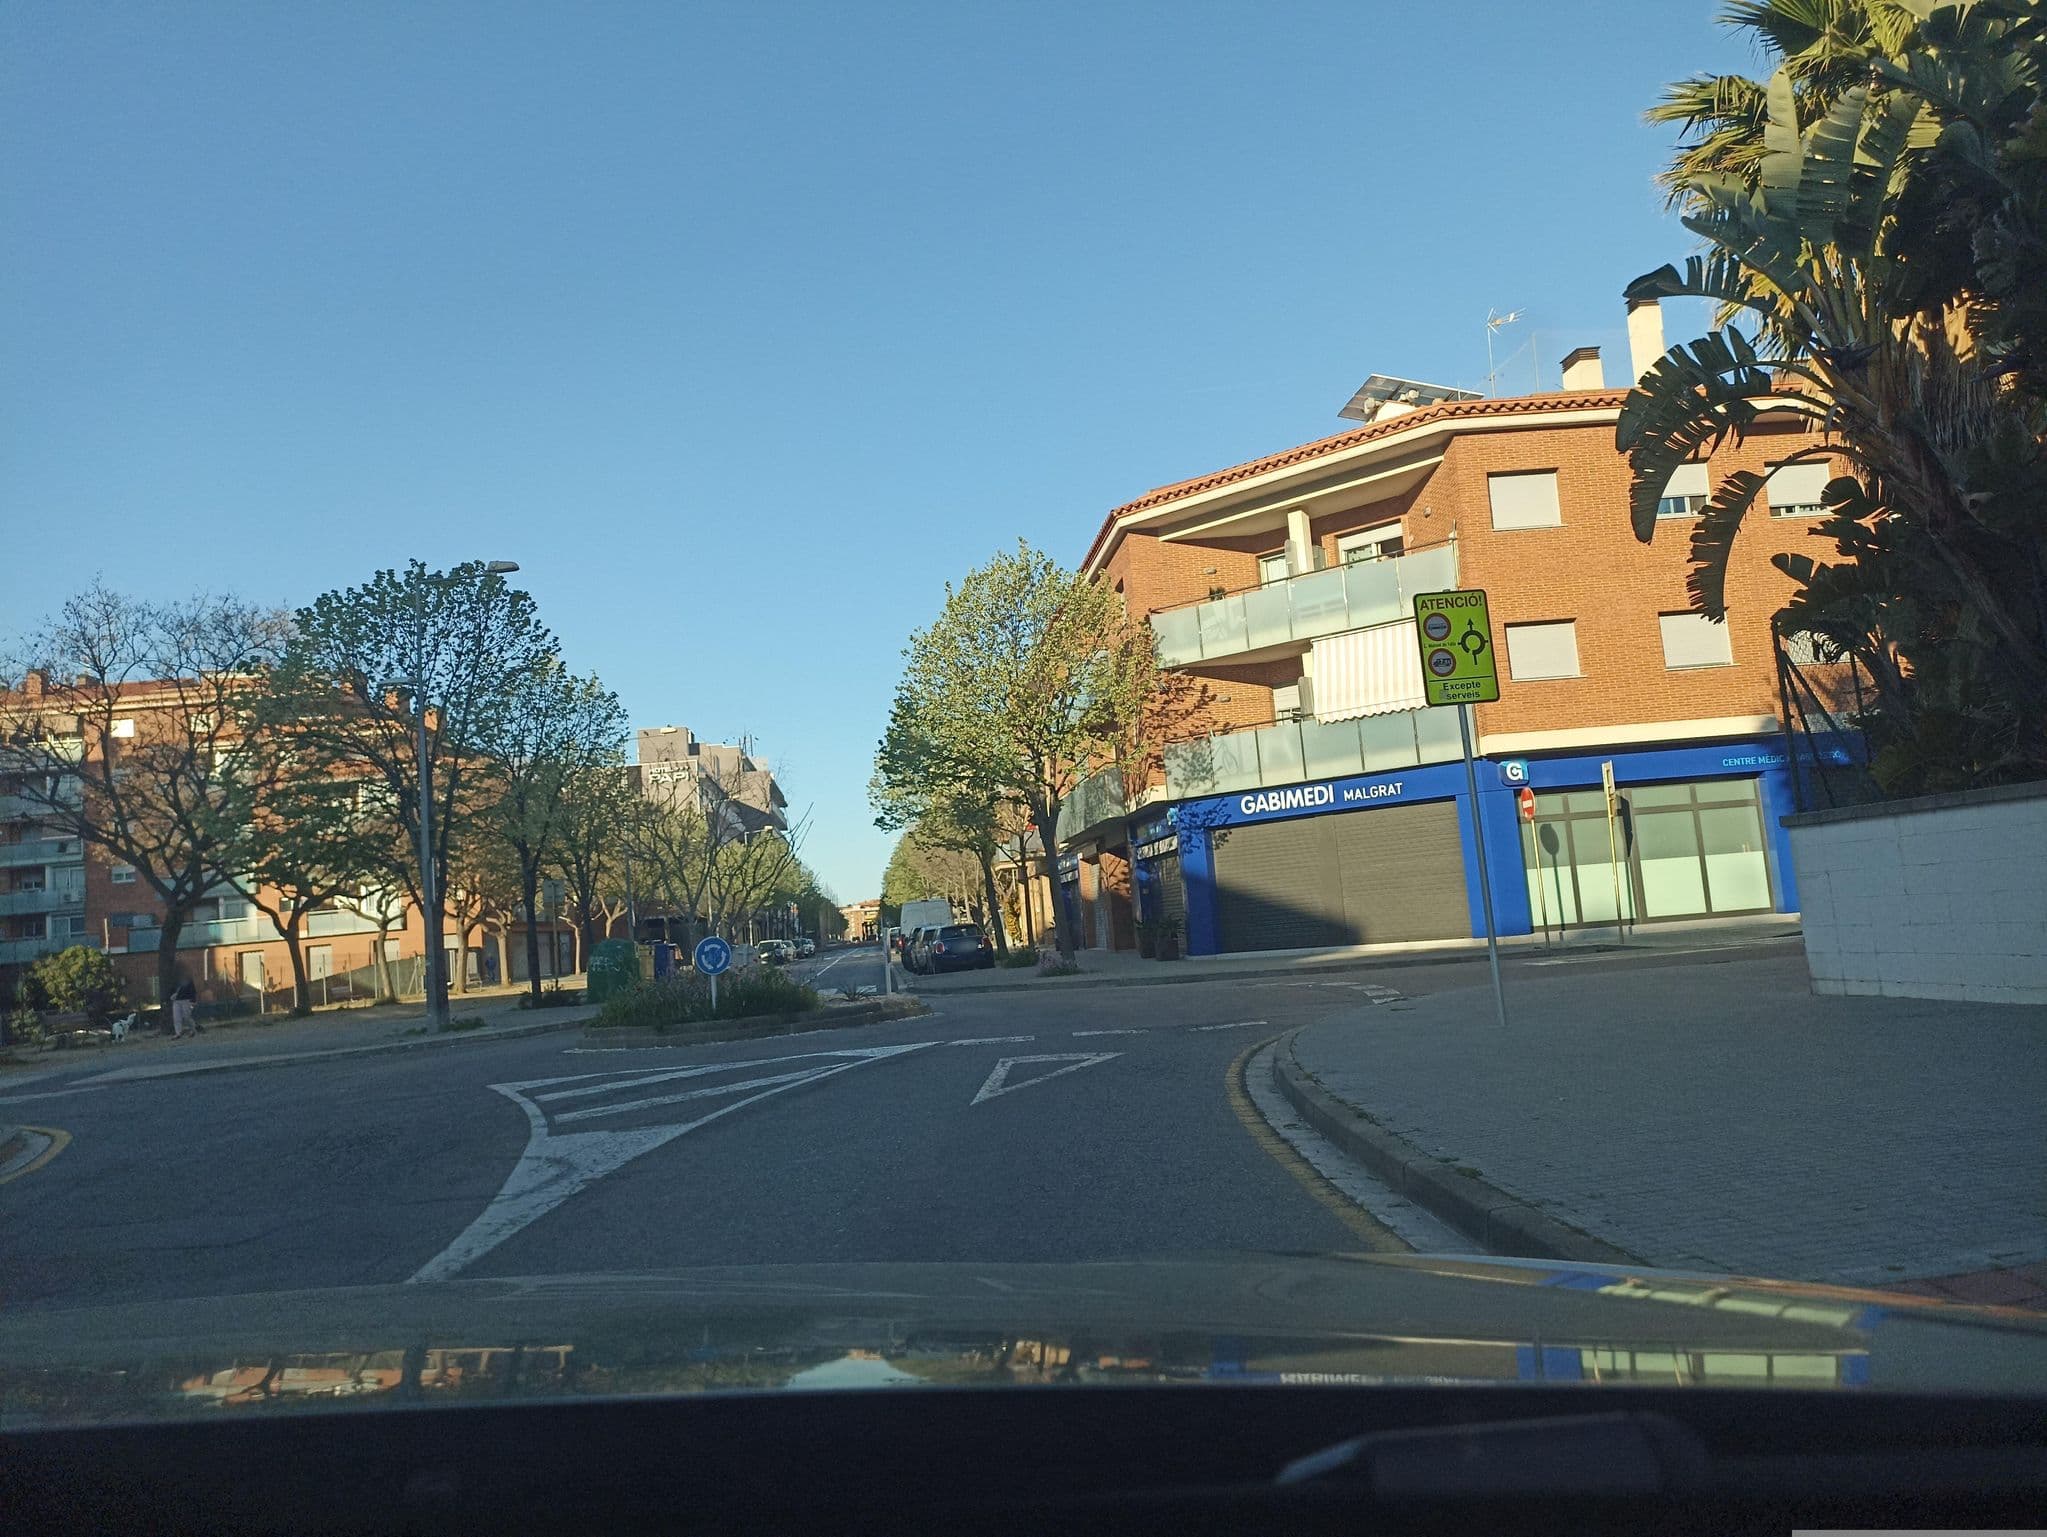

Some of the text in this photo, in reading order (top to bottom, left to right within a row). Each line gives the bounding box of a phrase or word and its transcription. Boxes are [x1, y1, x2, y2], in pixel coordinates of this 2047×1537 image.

[1420, 593, 1482, 610] ATENCIÓ!
[1443, 681, 1481, 691] Excepte
[1447, 691, 1480, 700] serveis
[1722, 757, 1757, 767] CENTRE
[1240, 782, 1403, 815] GABIMEDI MALGRAT
